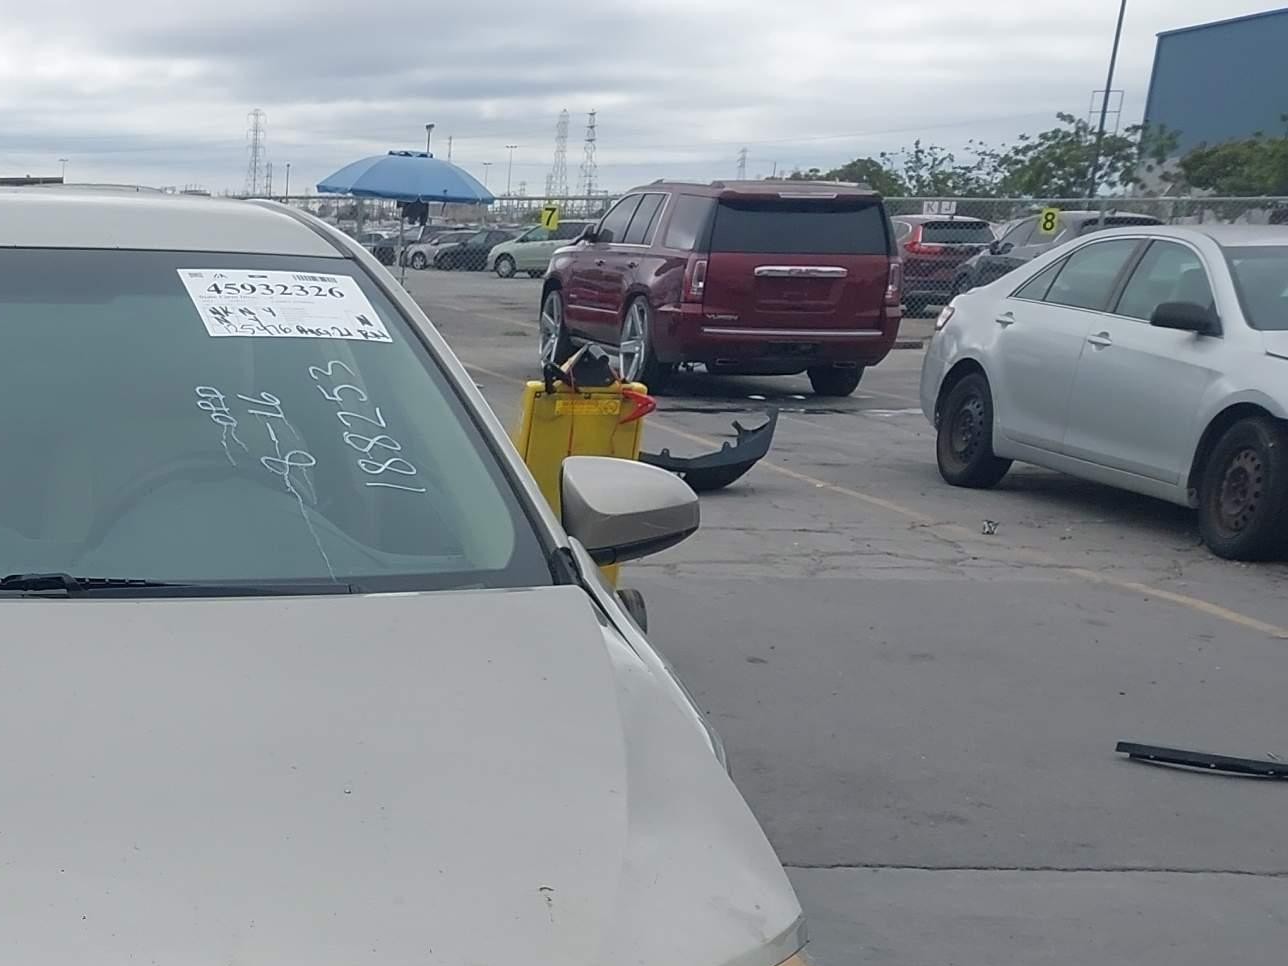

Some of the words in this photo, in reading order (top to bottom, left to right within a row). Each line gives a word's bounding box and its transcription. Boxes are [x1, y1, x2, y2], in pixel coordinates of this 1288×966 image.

[545, 208, 557, 226] 7
[1042, 212, 1055, 231] 8
[206, 282, 345, 299] 45932326
[308, 359, 427, 493] 188253
